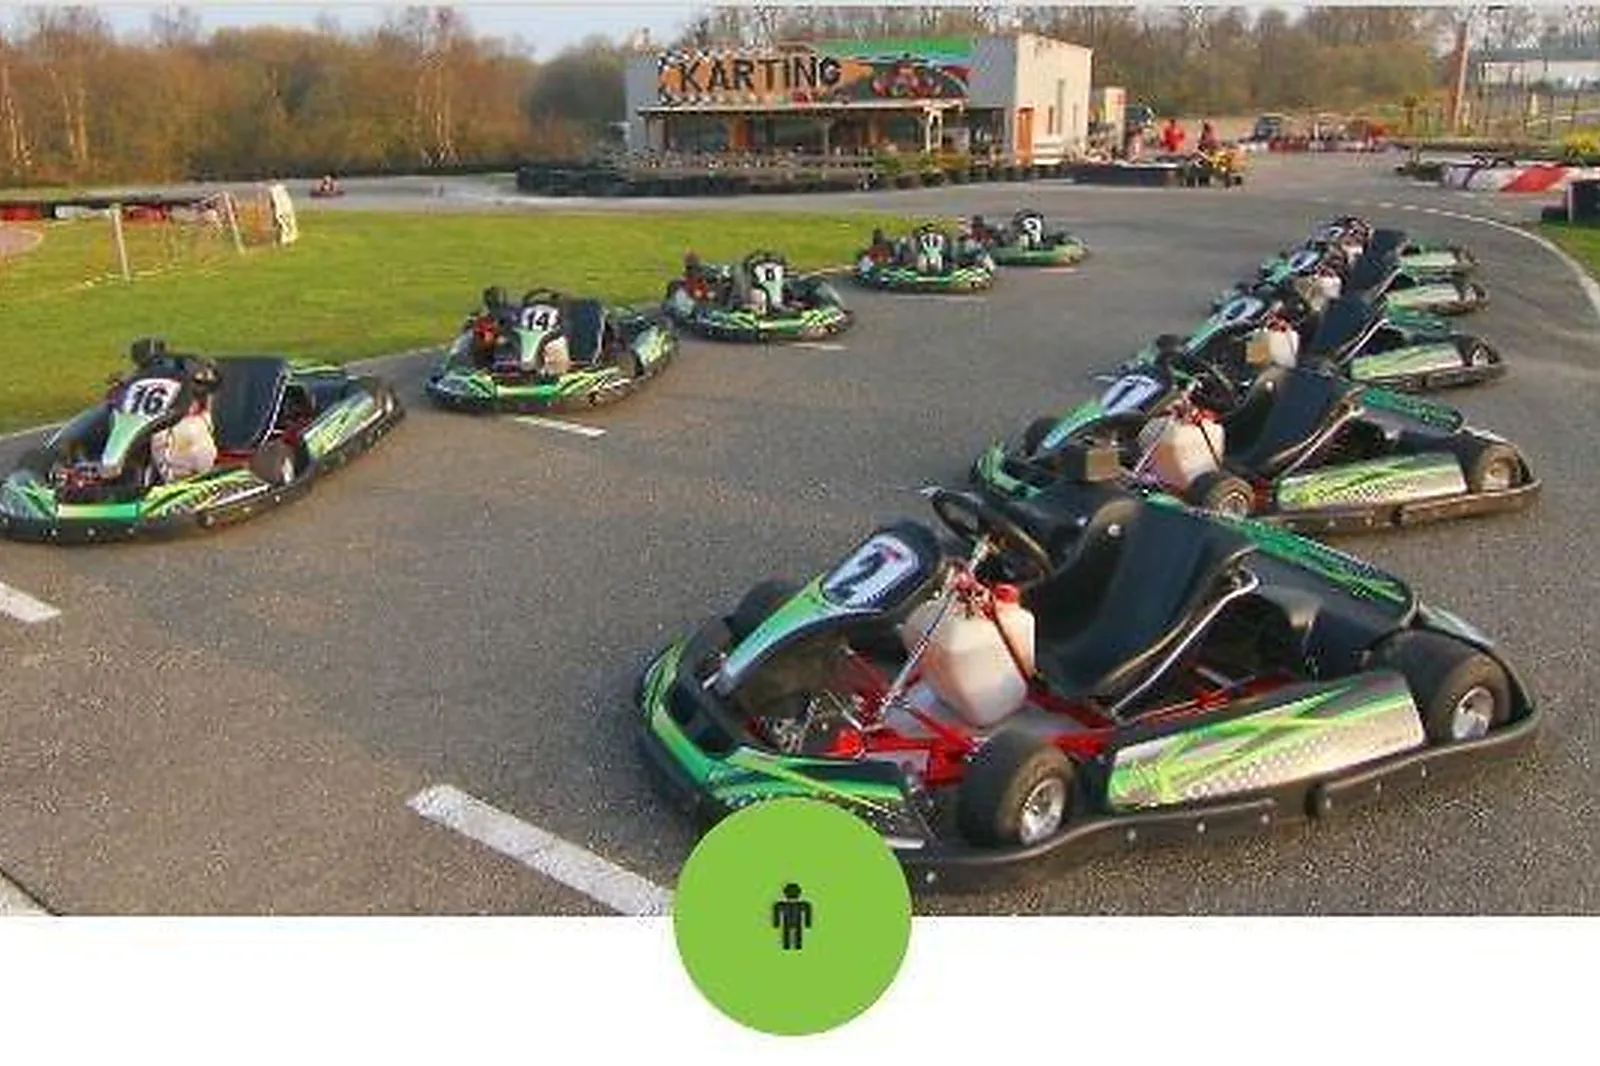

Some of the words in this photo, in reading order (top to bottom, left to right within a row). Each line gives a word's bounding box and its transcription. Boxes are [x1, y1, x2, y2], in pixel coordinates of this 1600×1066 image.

[680, 55, 842, 93] KARTING
[527, 310, 549, 331] 14
[130, 385, 168, 414] 16
